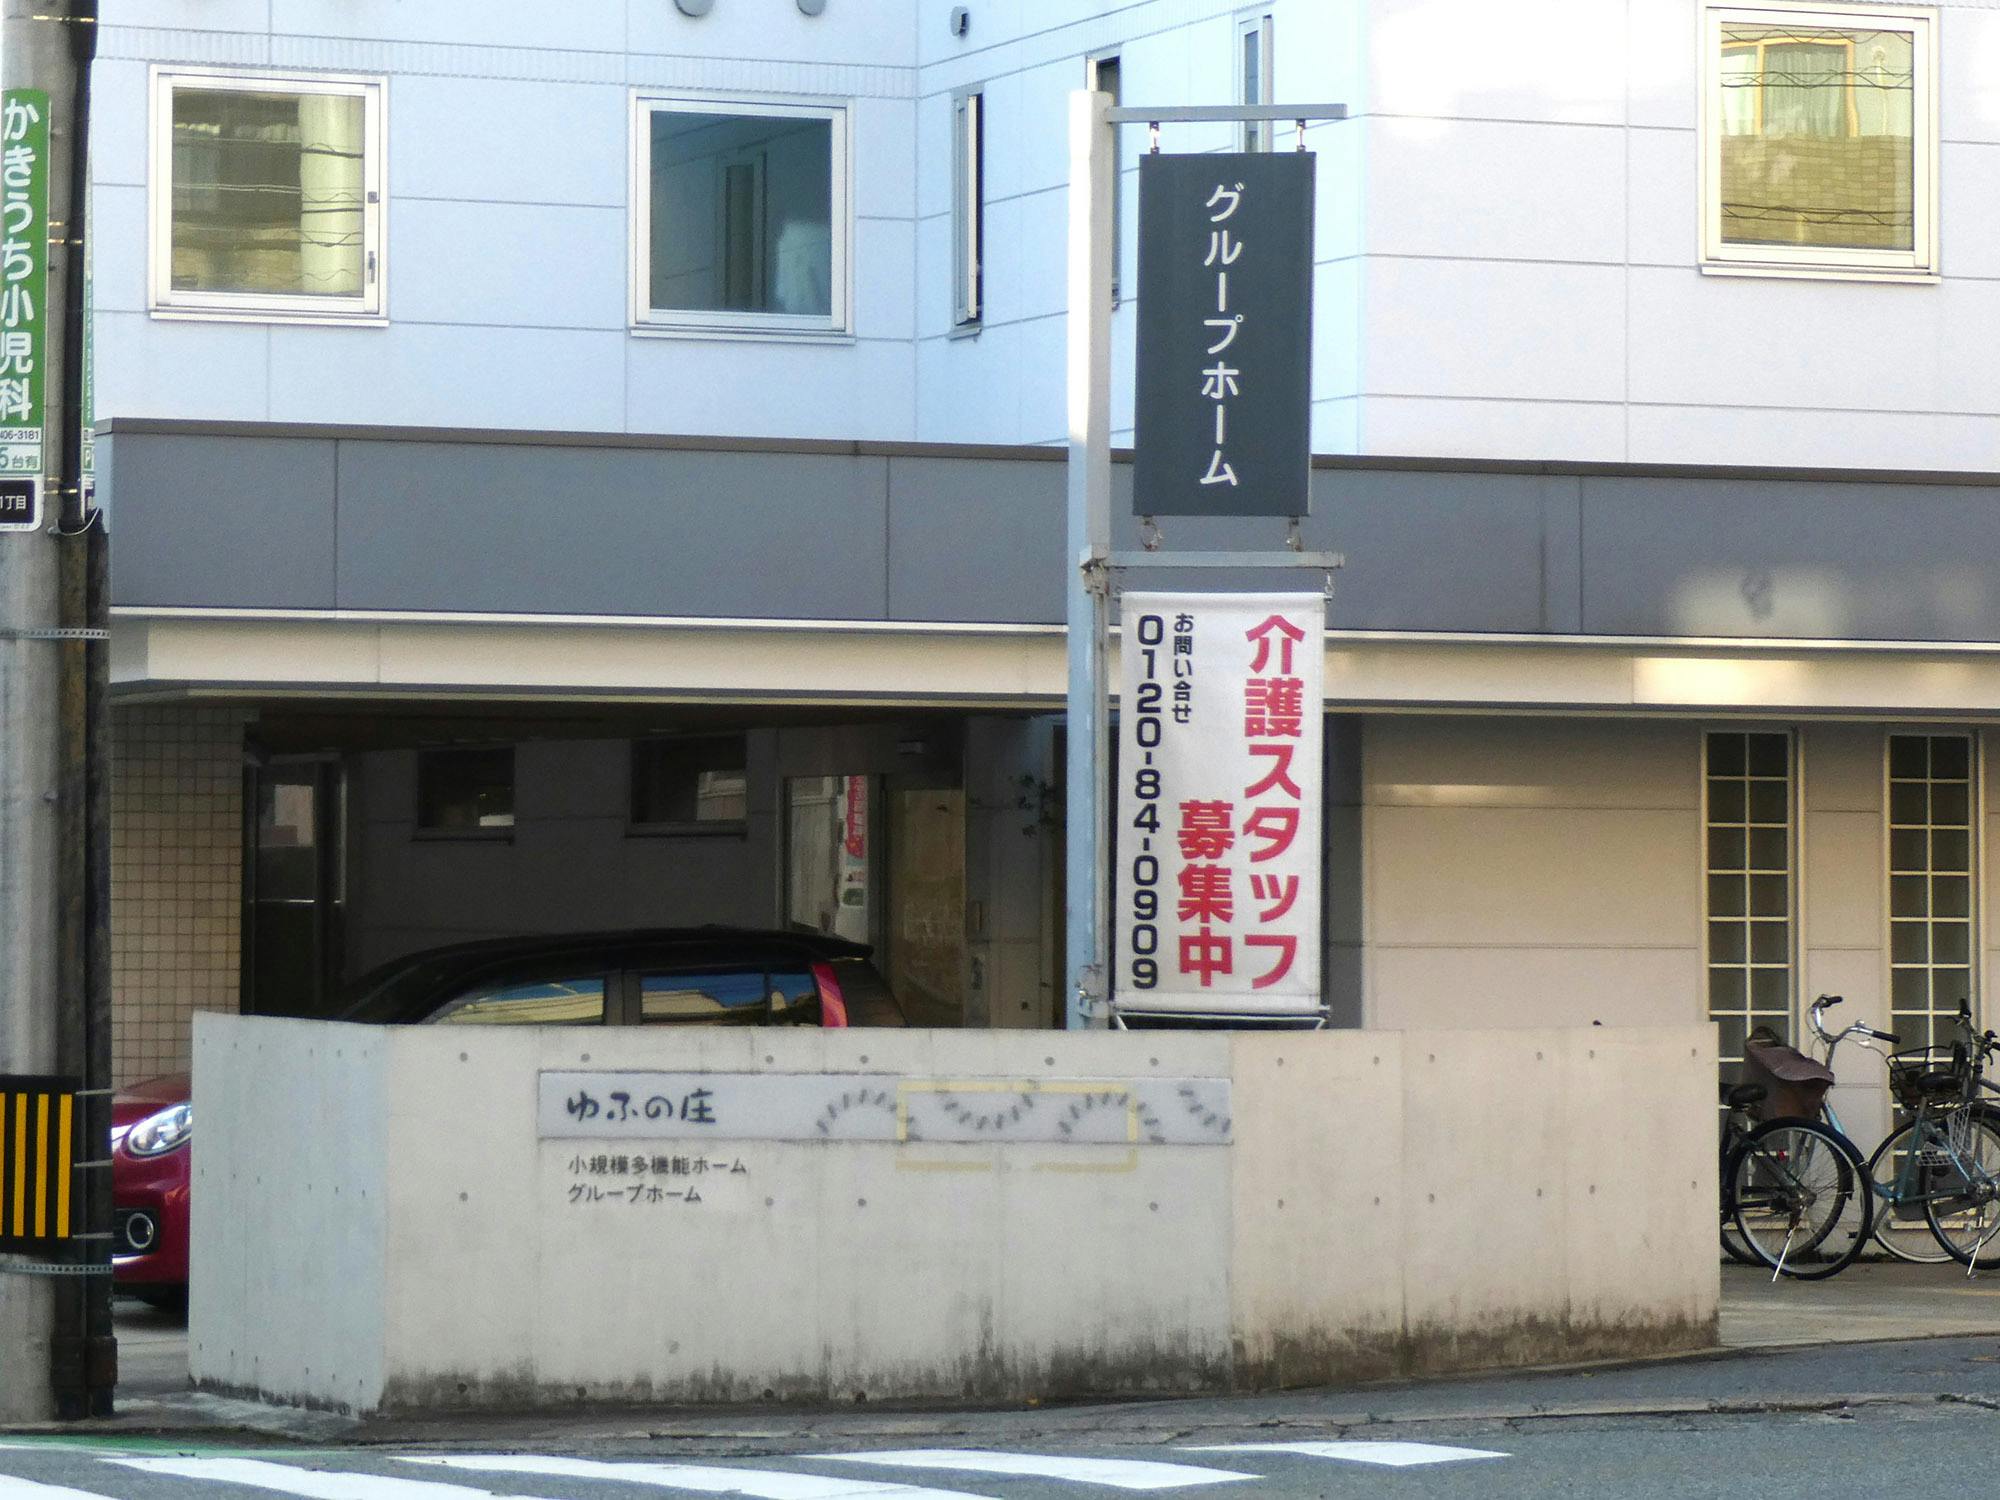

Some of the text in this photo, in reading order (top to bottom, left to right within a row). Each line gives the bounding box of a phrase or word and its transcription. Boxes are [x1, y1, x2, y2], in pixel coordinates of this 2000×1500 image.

[1200, 182, 1245, 488] グループホーム
[1172, 613, 1194, 724] お問い合せ
[1132, 614, 1164, 990] 0120-84-0909
[1242, 614, 1306, 990] 介護スタッフ
[1177, 799, 1236, 988] 募集中
[567, 1087, 717, 1124] ゆふの庄
[568, 1154, 748, 1175] 小規模多機能ホーム
[568, 1182, 703, 1204] グループホーム
